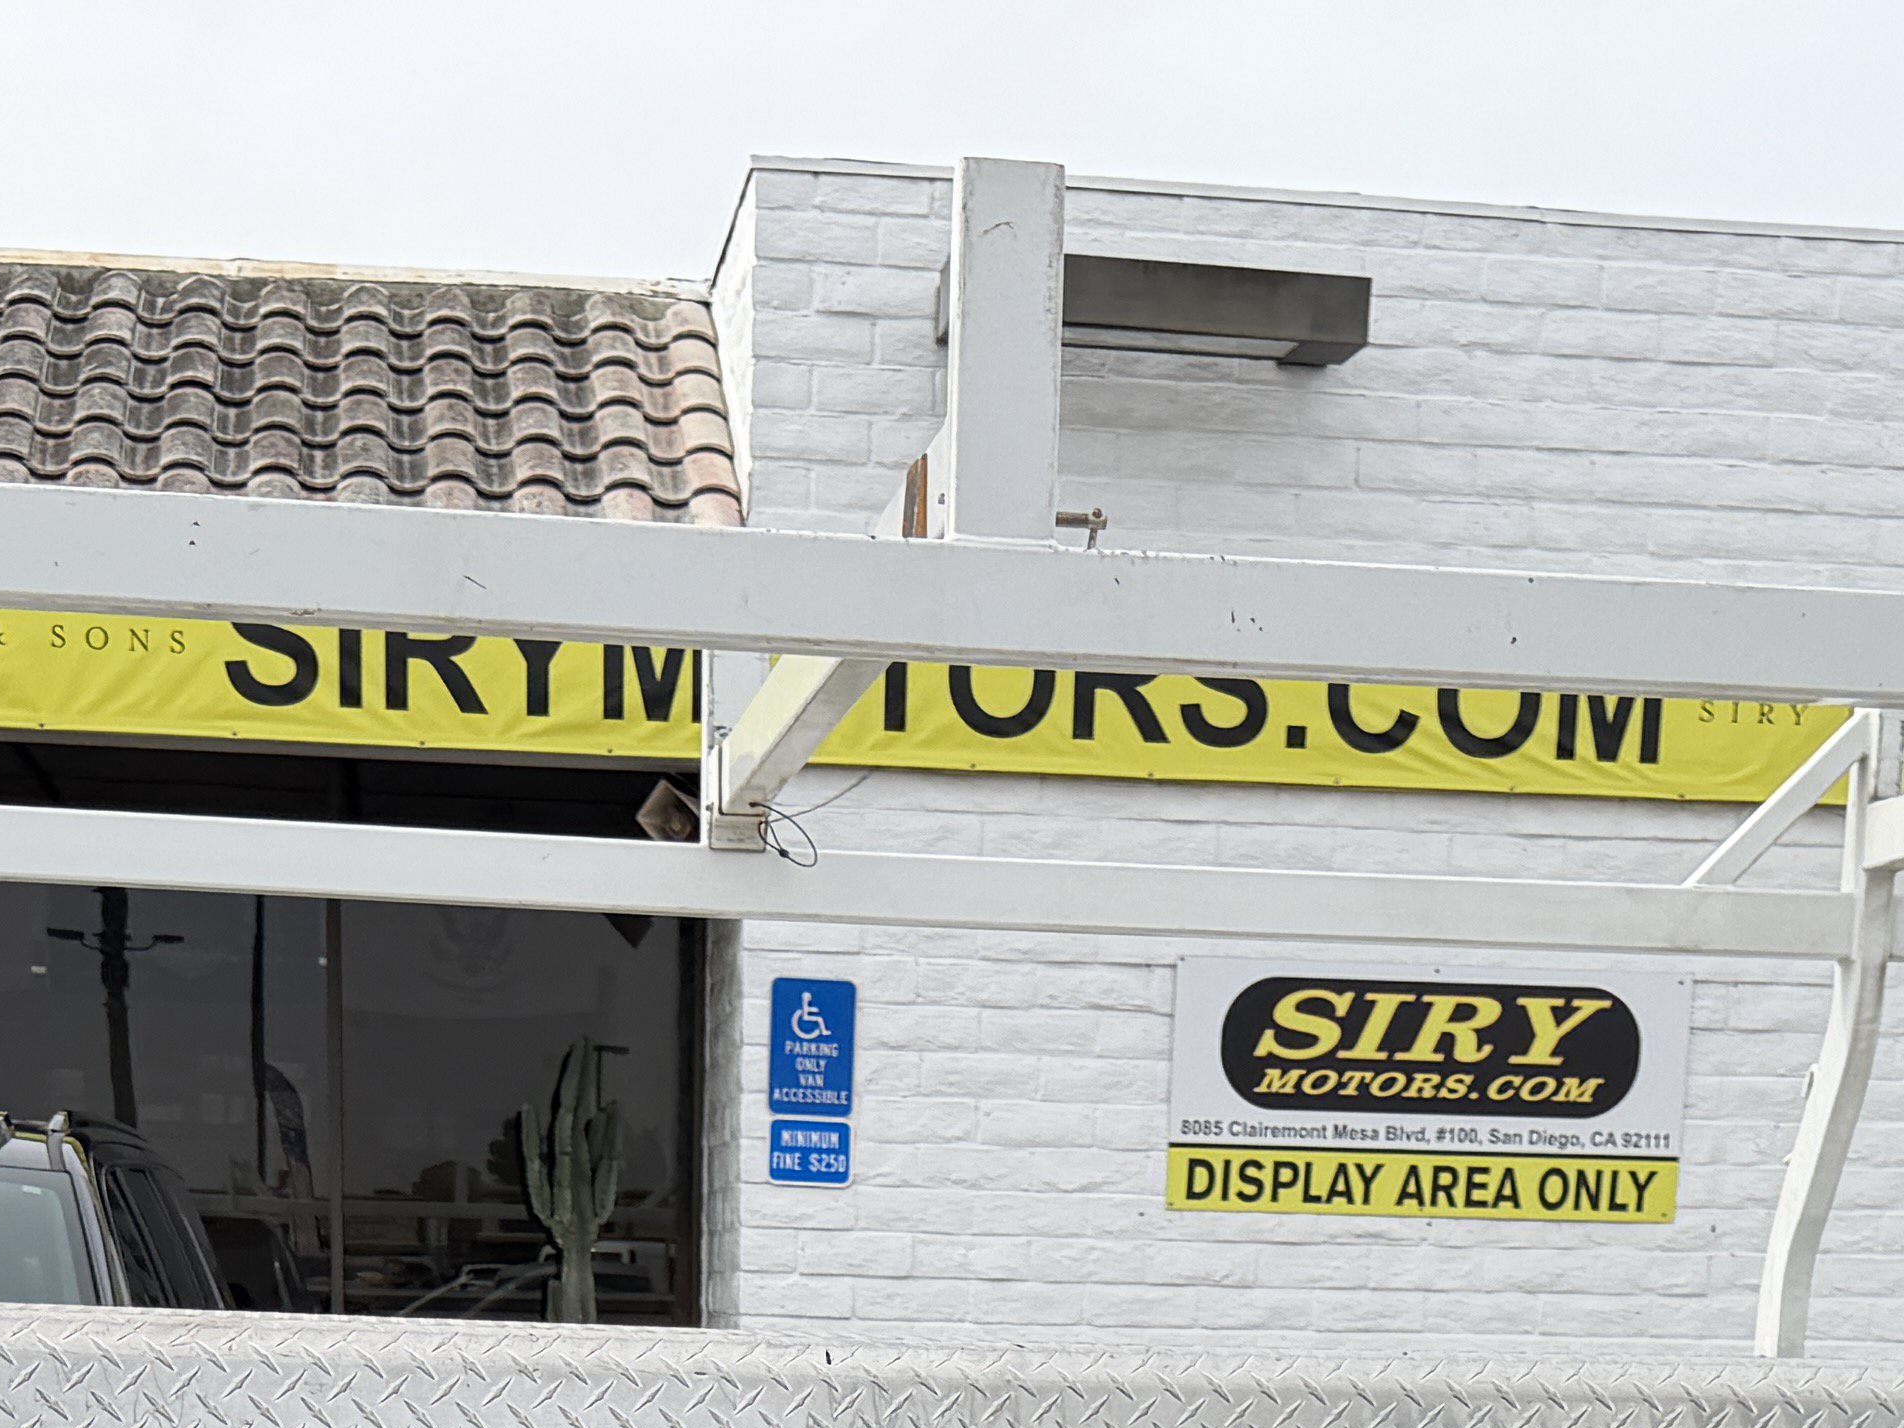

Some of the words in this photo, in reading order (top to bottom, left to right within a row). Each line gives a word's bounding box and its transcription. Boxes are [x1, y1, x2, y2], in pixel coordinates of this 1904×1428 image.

[51, 622, 189, 656] SONS
[224, 622, 1663, 766] SIRYMORS.COM
[1697, 699, 1811, 727] SIRY
[1254, 987, 1614, 1066] SIRY
[785, 1041, 839, 1057] PARKING
[795, 1058, 827, 1072] ONLY
[798, 1073, 824, 1088] VAN
[1252, 1067, 1605, 1106] MOTORS.COM
[773, 1088, 849, 1104] ACCESSIBLE
[781, 1130, 840, 1149] MINIMUM
[1181, 1119, 1224, 1137] 8085
[1228, 1120, 1328, 1141] Clairemont
[1332, 1123, 1380, 1141] Mesa
[1385, 1125, 1431, 1146] Blvd,
[1435, 1127, 1483, 1147] #100,
[1488, 1129, 1523, 1146] San
[1527, 1130, 1586, 1151] Diego,
[1590, 1131, 1619, 1148] CA
[1621, 1132, 1672, 1151] 92111
[772, 1152, 802, 1170] FINE
[809, 1153, 847, 1173] $250
[1185, 1157, 1386, 1207] DISPLAY
[1395, 1164, 1522, 1210] AREA
[1538, 1167, 1659, 1213] ONLY
